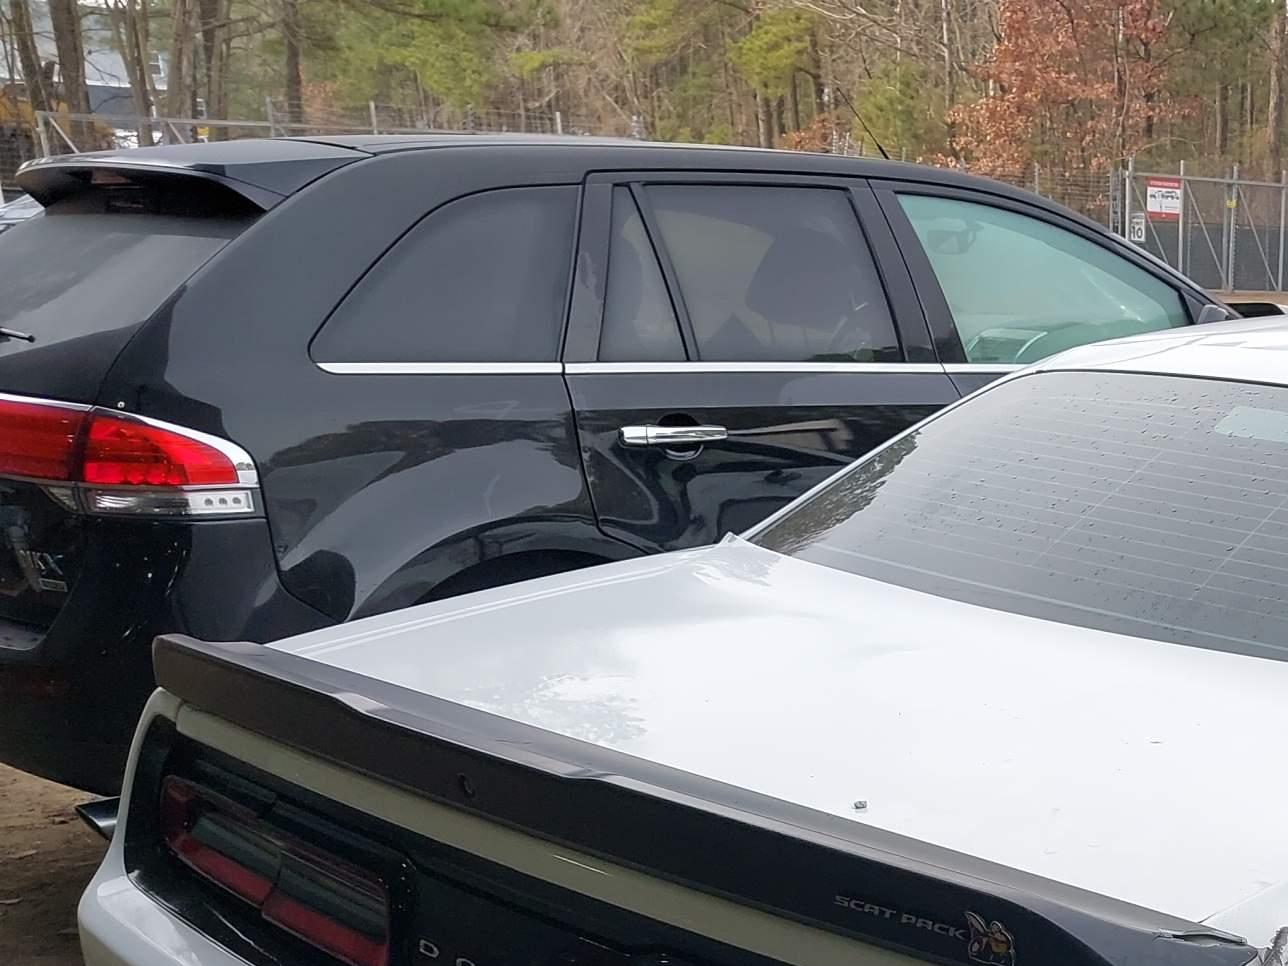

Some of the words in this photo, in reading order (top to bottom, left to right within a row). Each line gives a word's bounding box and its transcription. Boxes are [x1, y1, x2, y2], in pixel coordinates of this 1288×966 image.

[1131, 225, 1143, 239] 10
[833, 894, 897, 919] SCAT
[900, 912, 969, 942] PACK
